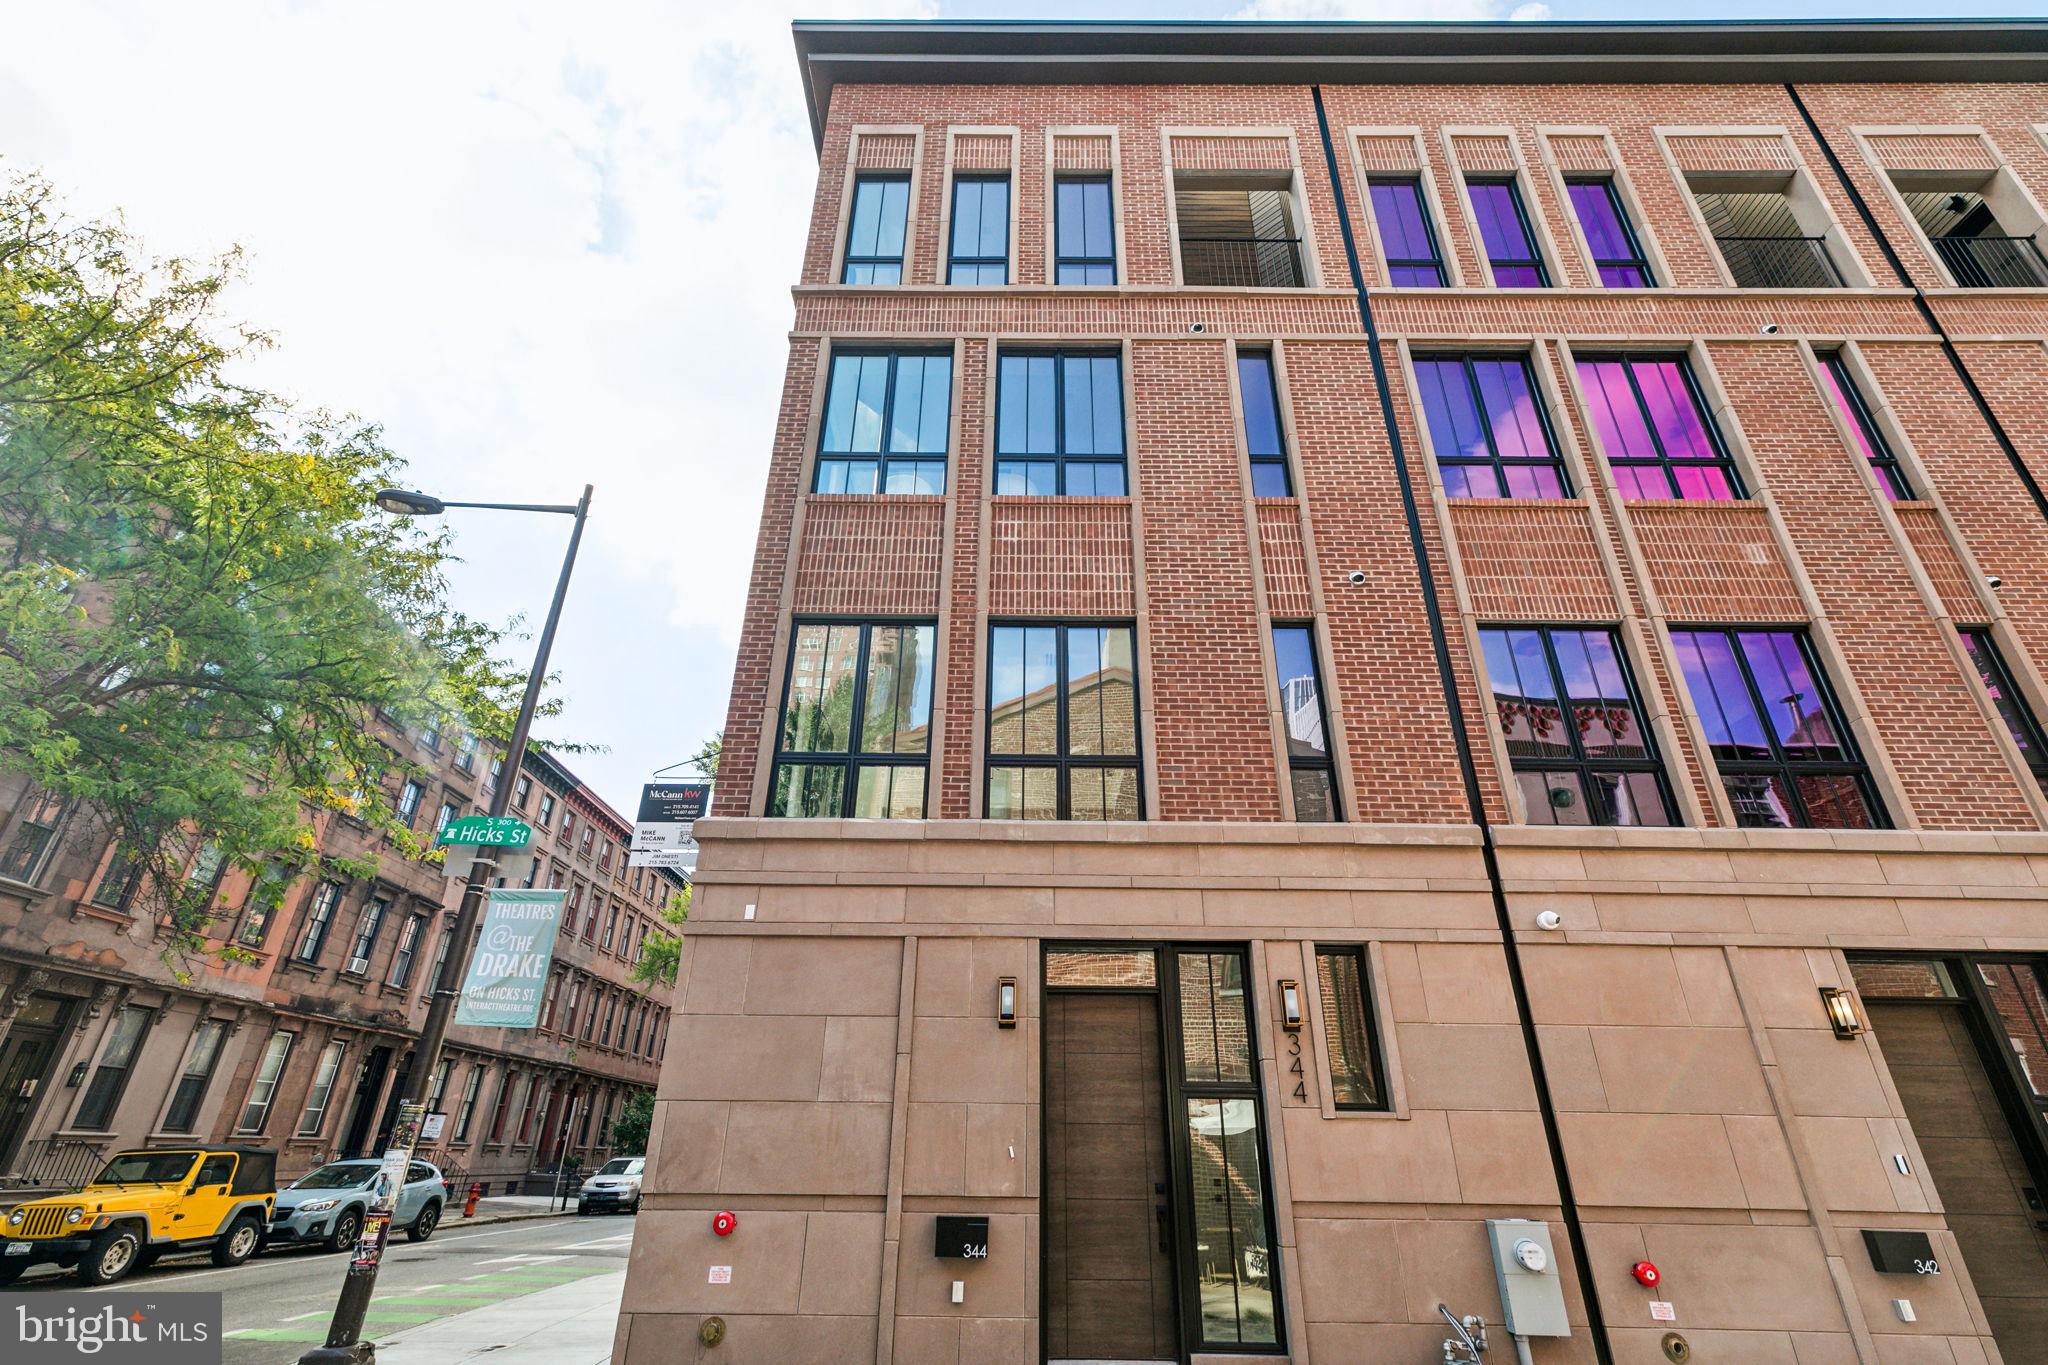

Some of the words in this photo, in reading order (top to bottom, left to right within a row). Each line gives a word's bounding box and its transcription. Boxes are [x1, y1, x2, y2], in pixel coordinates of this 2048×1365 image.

[487, 817, 494, 826] S
[460, 825, 505, 843] Hicks
[509, 828, 527, 844] St
[495, 903, 556, 920] THEATRES
[476, 952, 546, 979] DRAKE
[469, 986, 487, 999] ON
[488, 987, 521, 1001] HICKS
[522, 988, 536, 1002] ST.
[1288, 1033, 1307, 1104] 344
[963, 1243, 987, 1258] 344
[1914, 1259, 1941, 1274] 342
